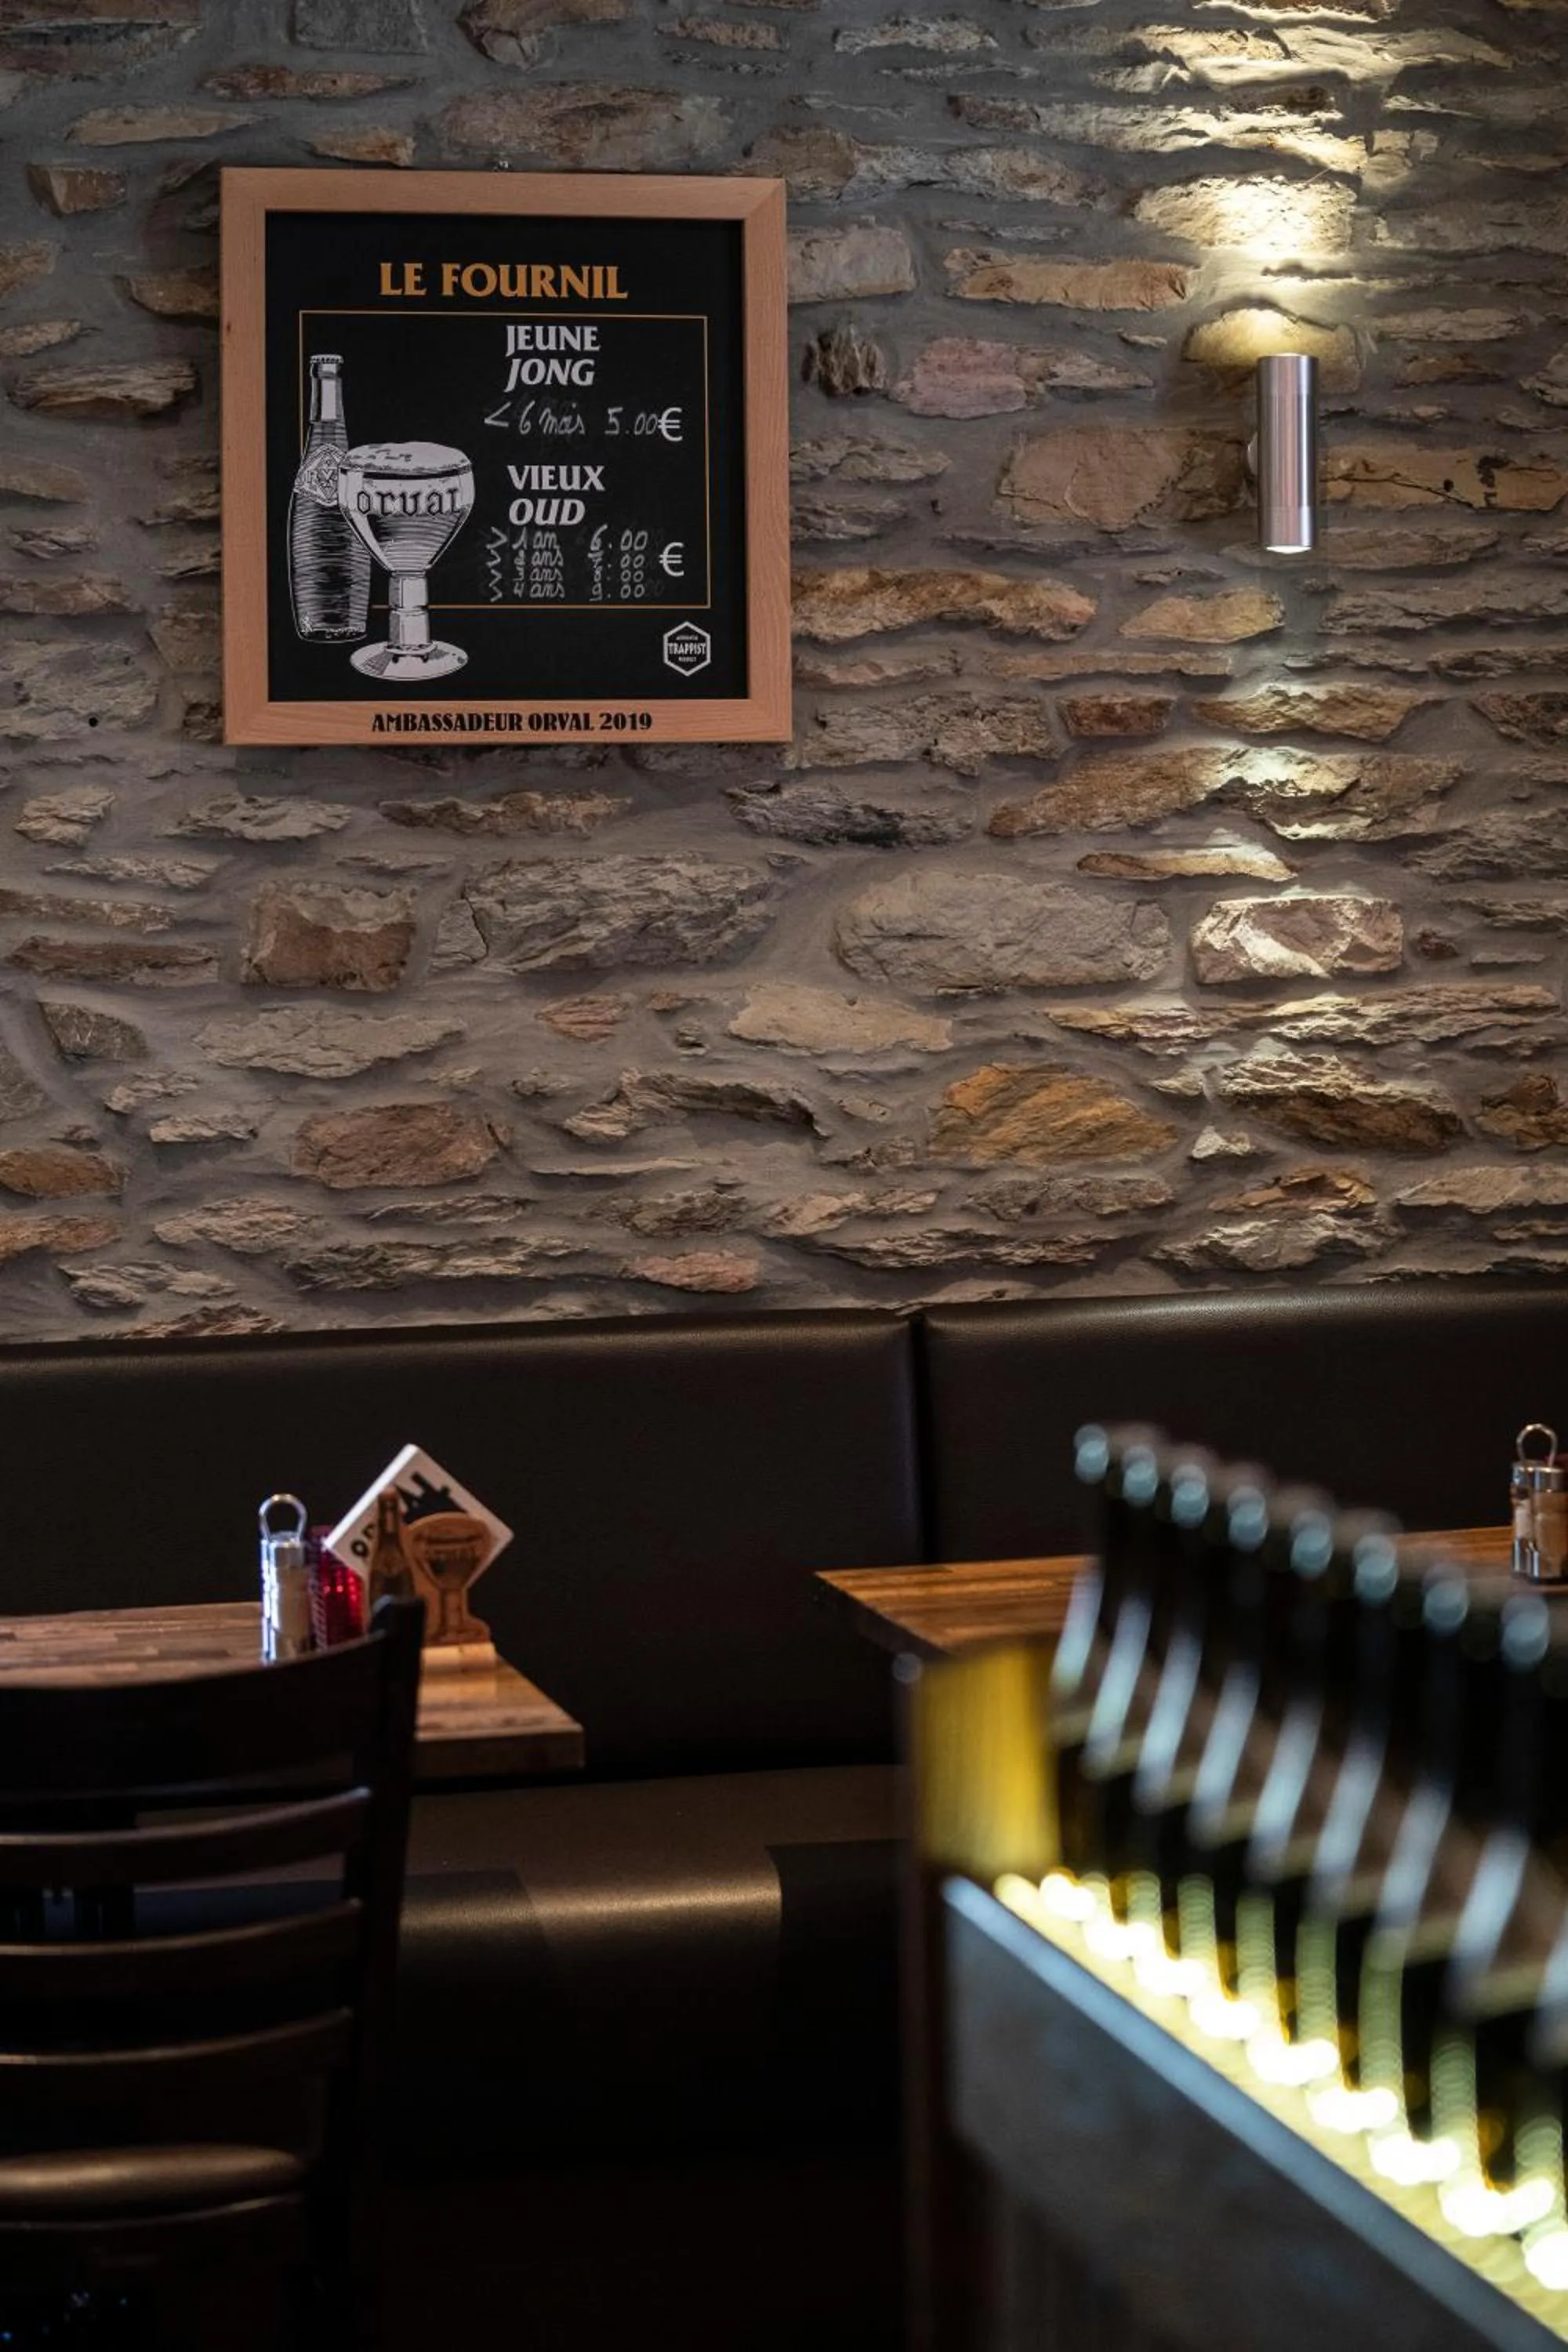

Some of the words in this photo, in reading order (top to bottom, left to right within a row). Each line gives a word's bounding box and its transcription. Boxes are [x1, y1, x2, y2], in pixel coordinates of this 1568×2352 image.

[379, 263, 426, 296] LE
[441, 263, 629, 299] FOURNIL
[506, 325, 601, 357] JEUNE
[504, 358, 595, 392] JONG
[506, 465, 605, 491] VIEUX
[509, 498, 586, 526] OUD
[668, 642, 706, 655] TRAPPIST
[372, 713, 523, 732] AMBASSADEUR
[528, 712, 595, 731] ORVAL
[599, 712, 653, 731] 2019
